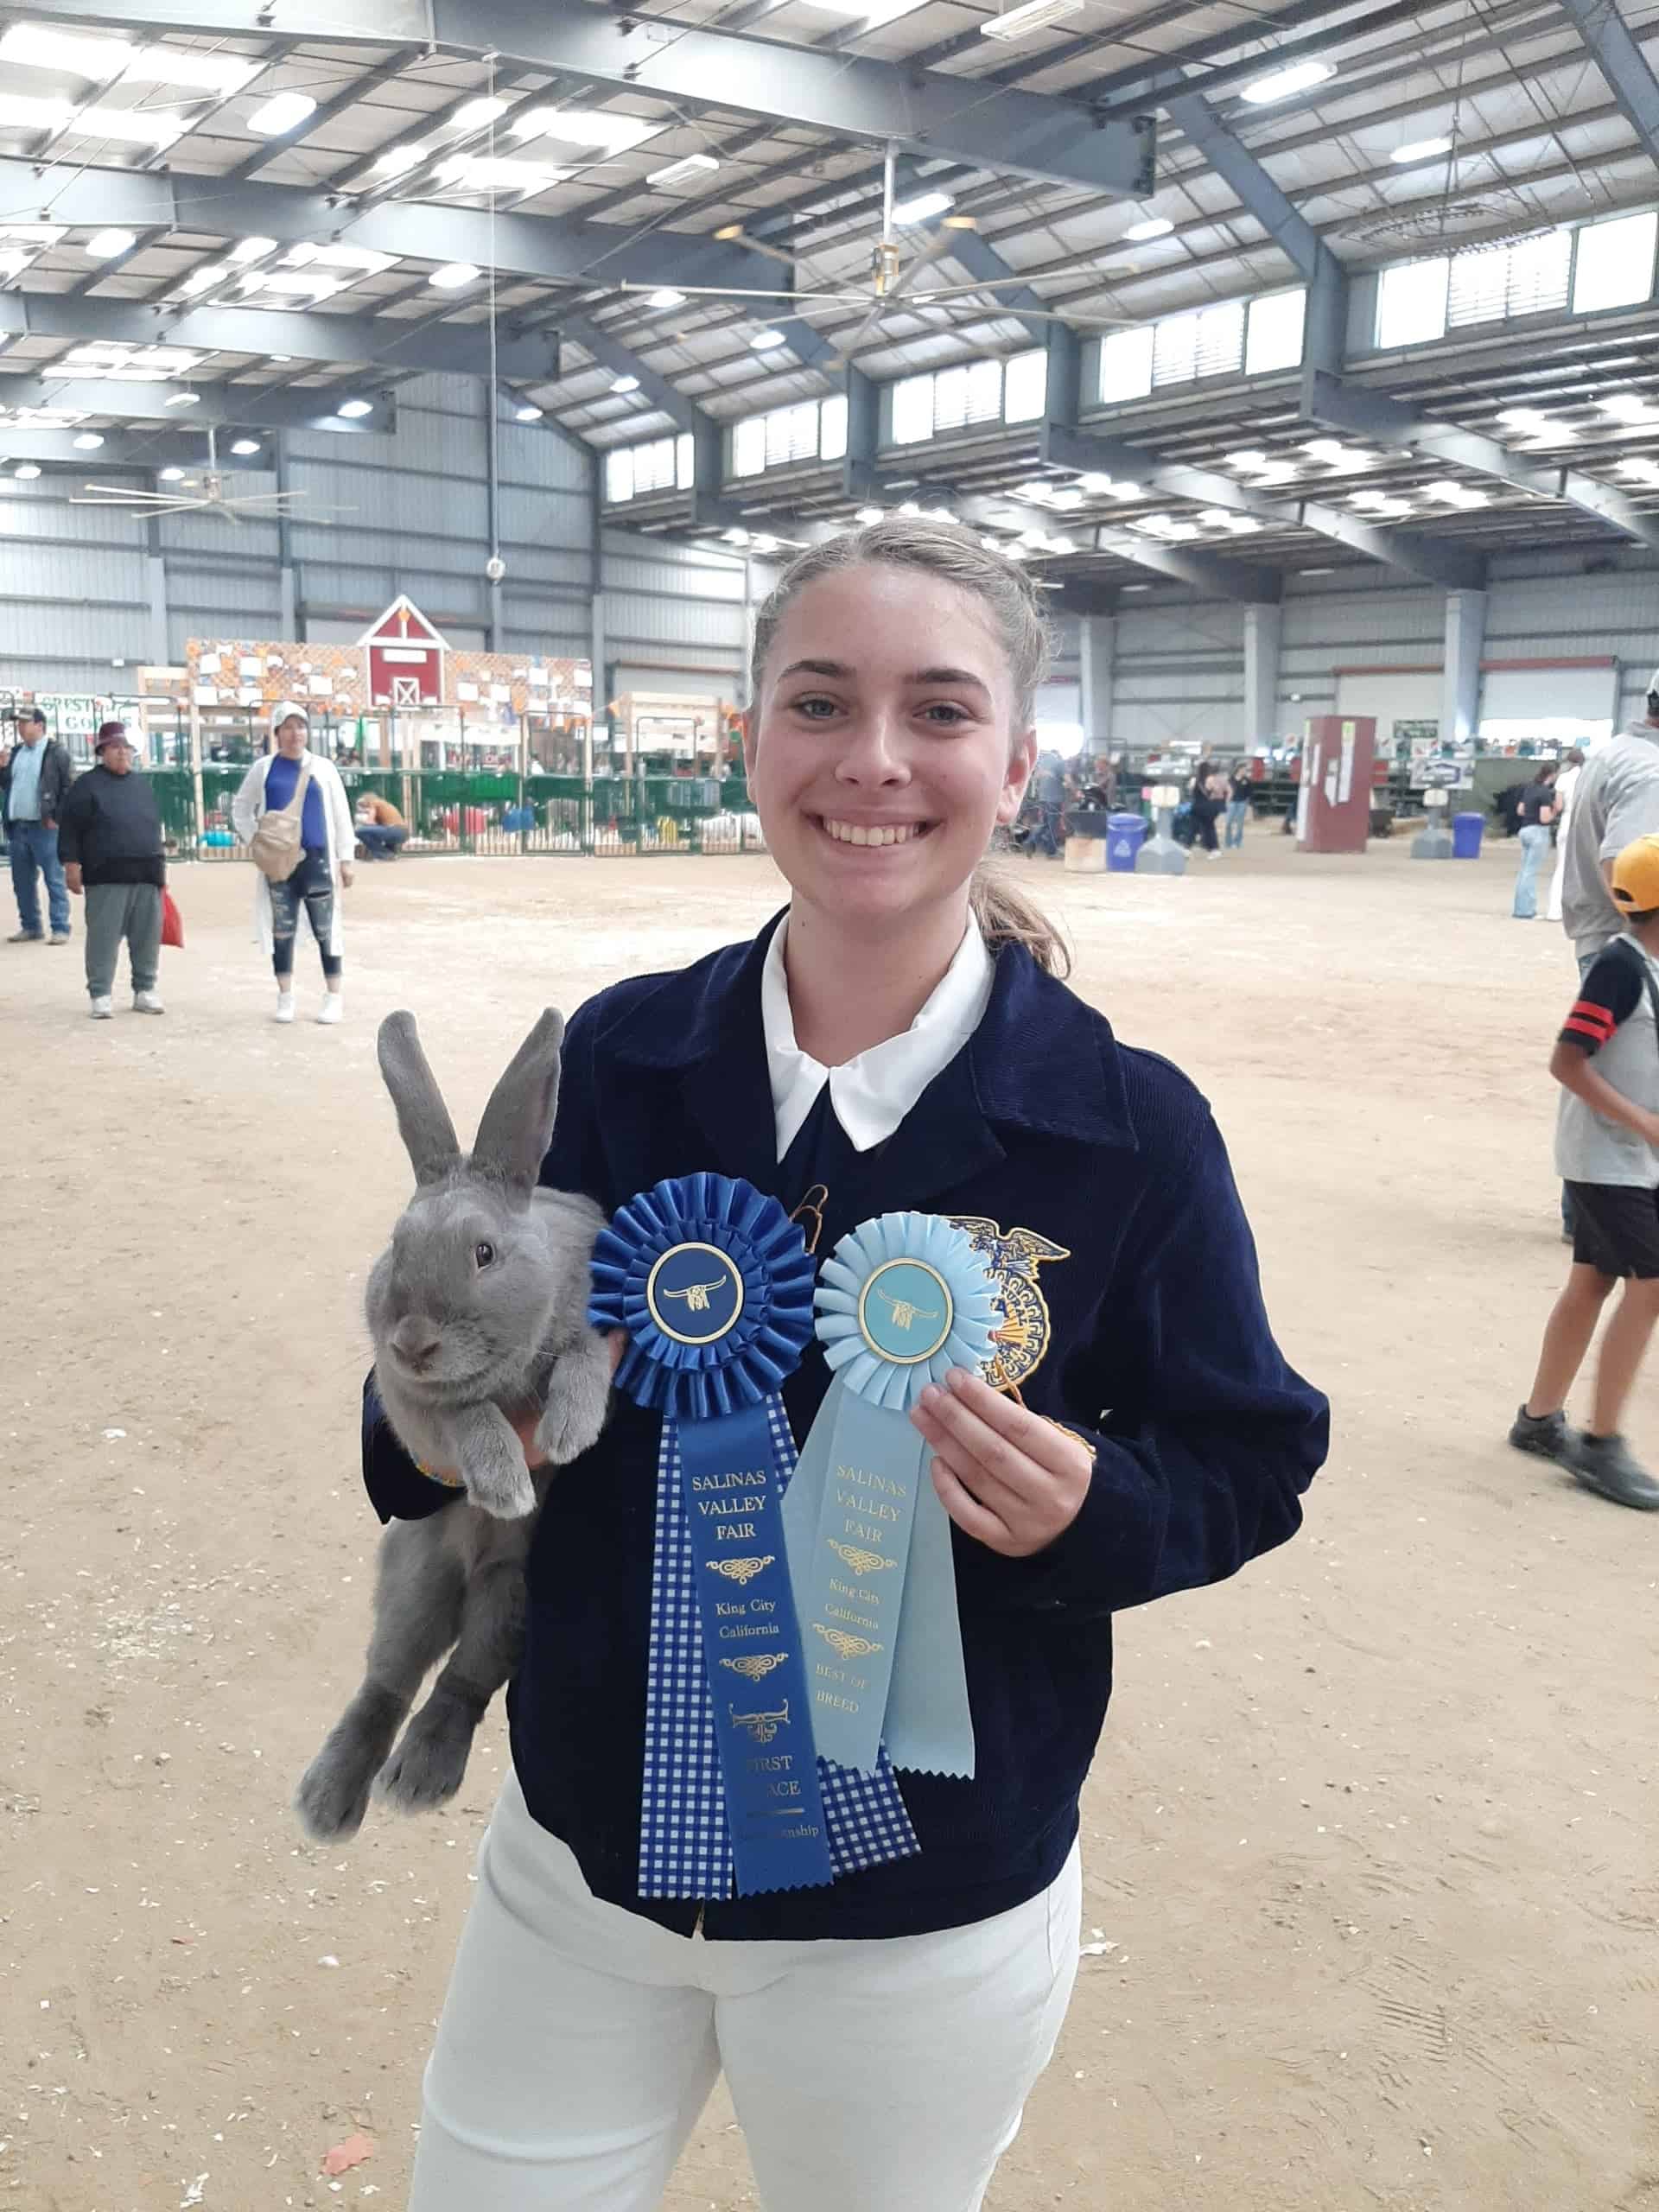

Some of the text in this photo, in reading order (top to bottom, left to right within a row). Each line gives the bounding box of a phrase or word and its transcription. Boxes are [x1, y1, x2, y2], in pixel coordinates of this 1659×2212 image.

[692, 1471, 767, 1491] SALINAS
[836, 1465, 906, 1497] SALINAS
[698, 1496, 766, 1515] VALLEY
[836, 1488, 901, 1522] VALLEY
[715, 1522, 757, 1540] FAIR
[844, 1518, 884, 1542] FAIR
[829, 1578, 857, 1598] King
[715, 1599, 777, 1616] King City
[824, 1603, 880, 1630] California
[719, 1623, 780, 1639] California
[816, 1689, 860, 1713] BREED
